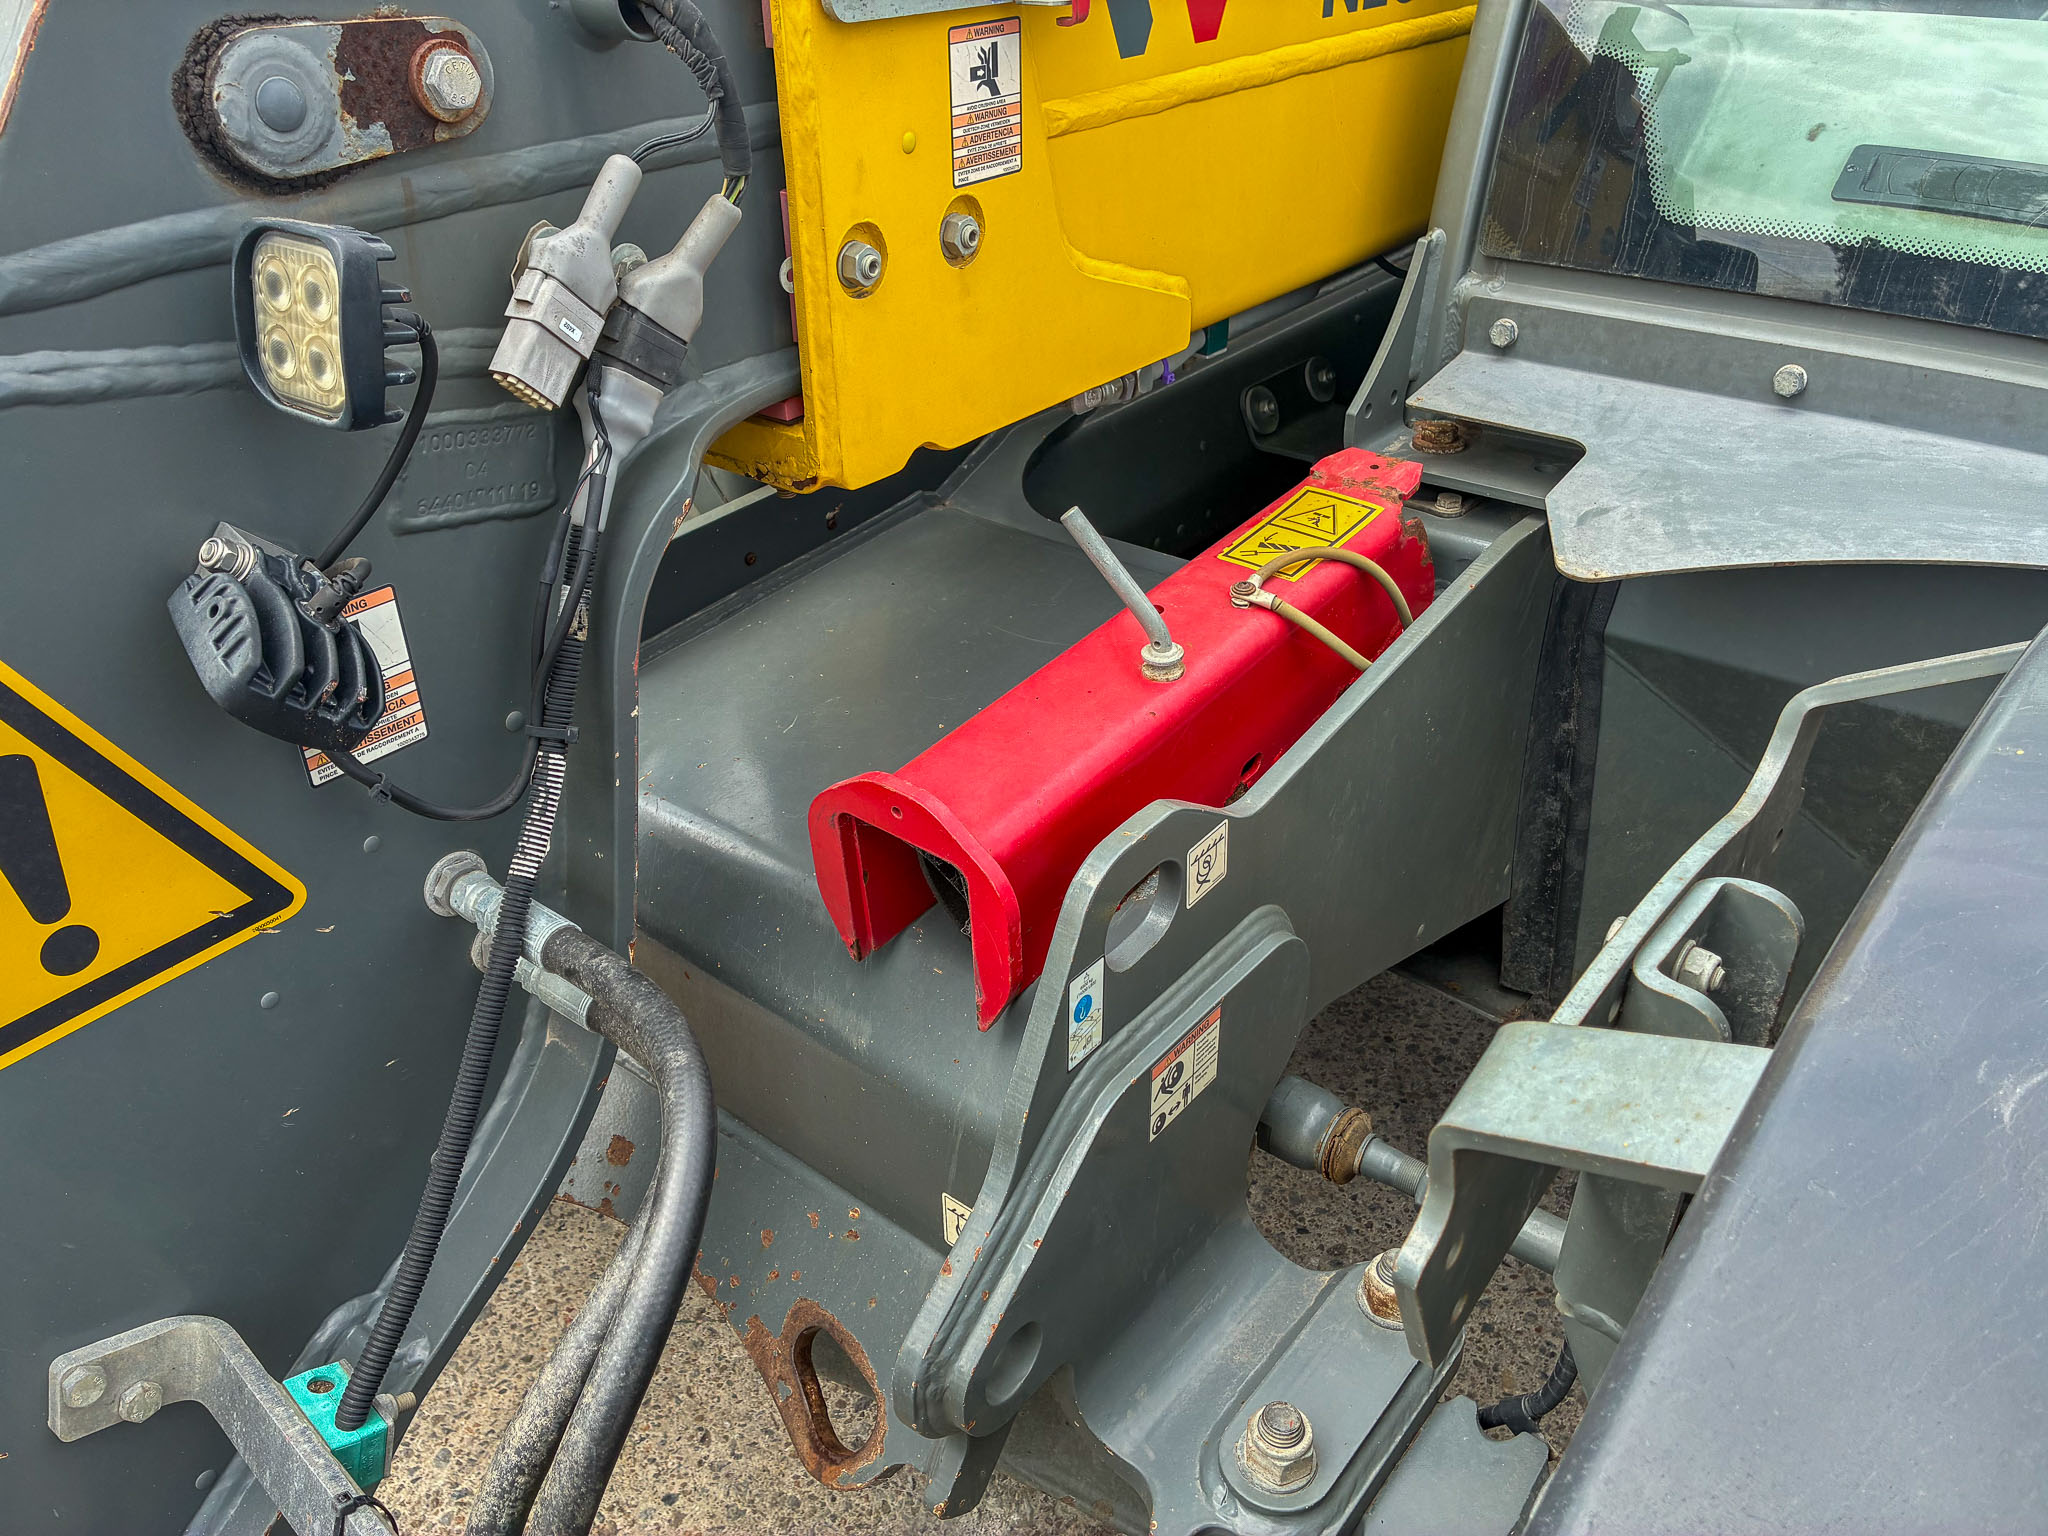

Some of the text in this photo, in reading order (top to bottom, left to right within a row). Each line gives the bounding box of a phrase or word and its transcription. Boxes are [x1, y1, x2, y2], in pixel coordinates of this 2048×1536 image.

[973, 24, 1005, 38] WARNING
[445, 61, 476, 80] CETIN
[451, 93, 466, 105] 8.8
[975, 107, 1007, 122] WARNUNG
[970, 127, 1014, 145] ADVERTENCIA
[966, 146, 1017, 165] AVERTISSEMENT
[341, 599, 368, 615] NING
[362, 714, 416, 746] ISSEMENT
[366, 729, 414, 753] RACCORDEMENT
[319, 770, 338, 781] PINCE
[1173, 1020, 1210, 1057] WARNING
